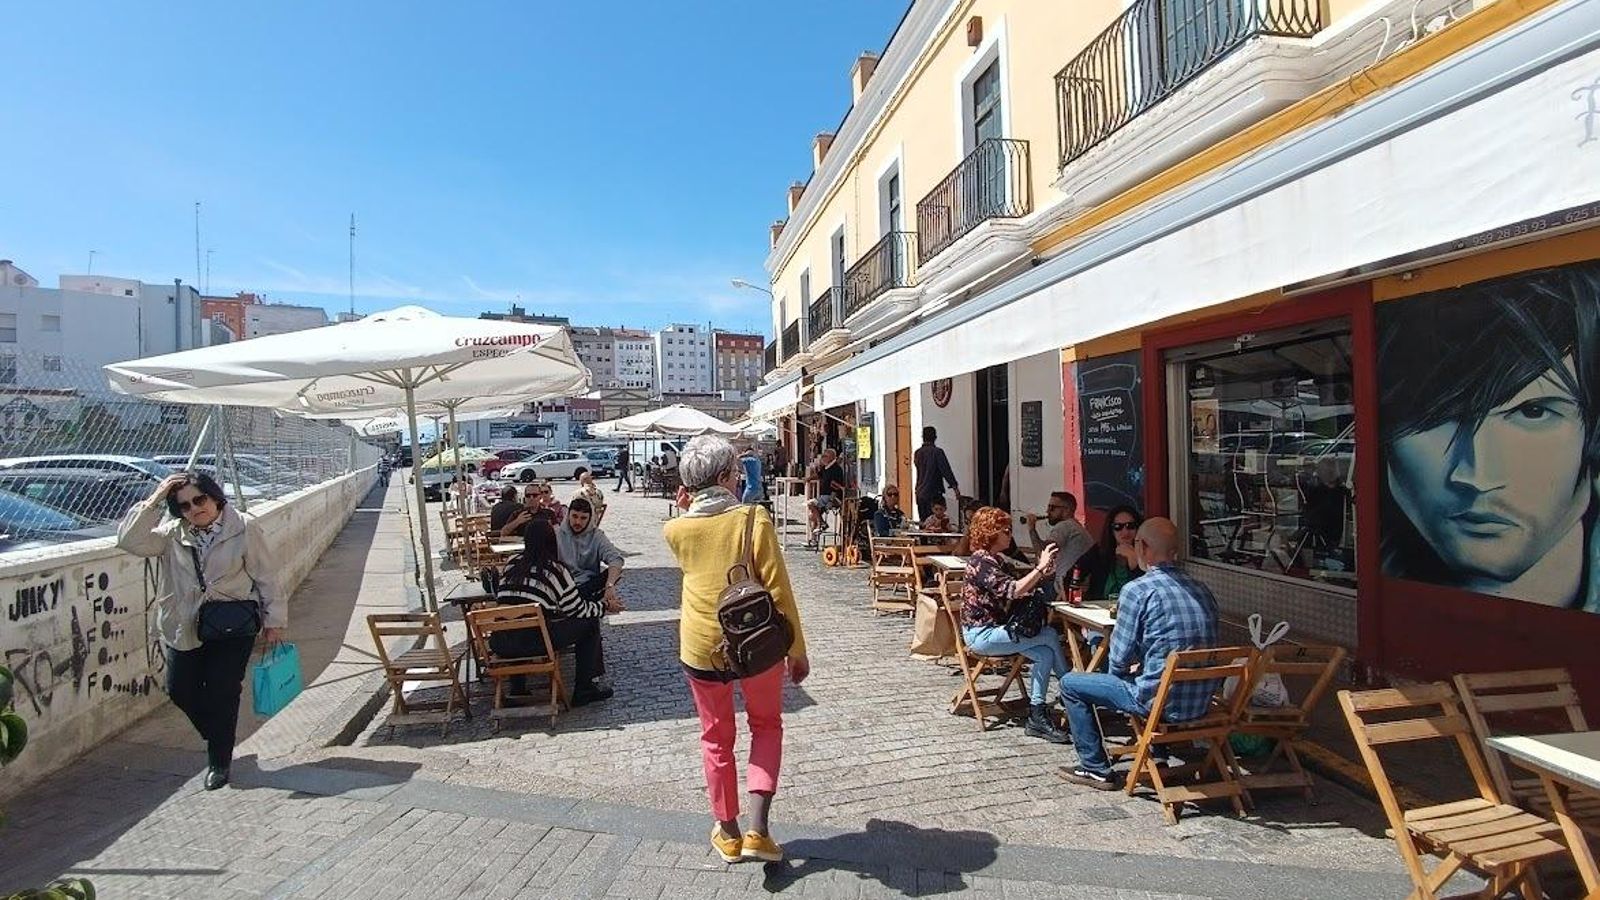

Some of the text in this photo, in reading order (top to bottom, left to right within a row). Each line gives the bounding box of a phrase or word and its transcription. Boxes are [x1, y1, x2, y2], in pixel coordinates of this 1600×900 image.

[1472, 234, 1492, 246] 959
[1496, 229, 1511, 241] 28
[1531, 219, 1547, 232] 93
[1565, 208, 1588, 222] 625
